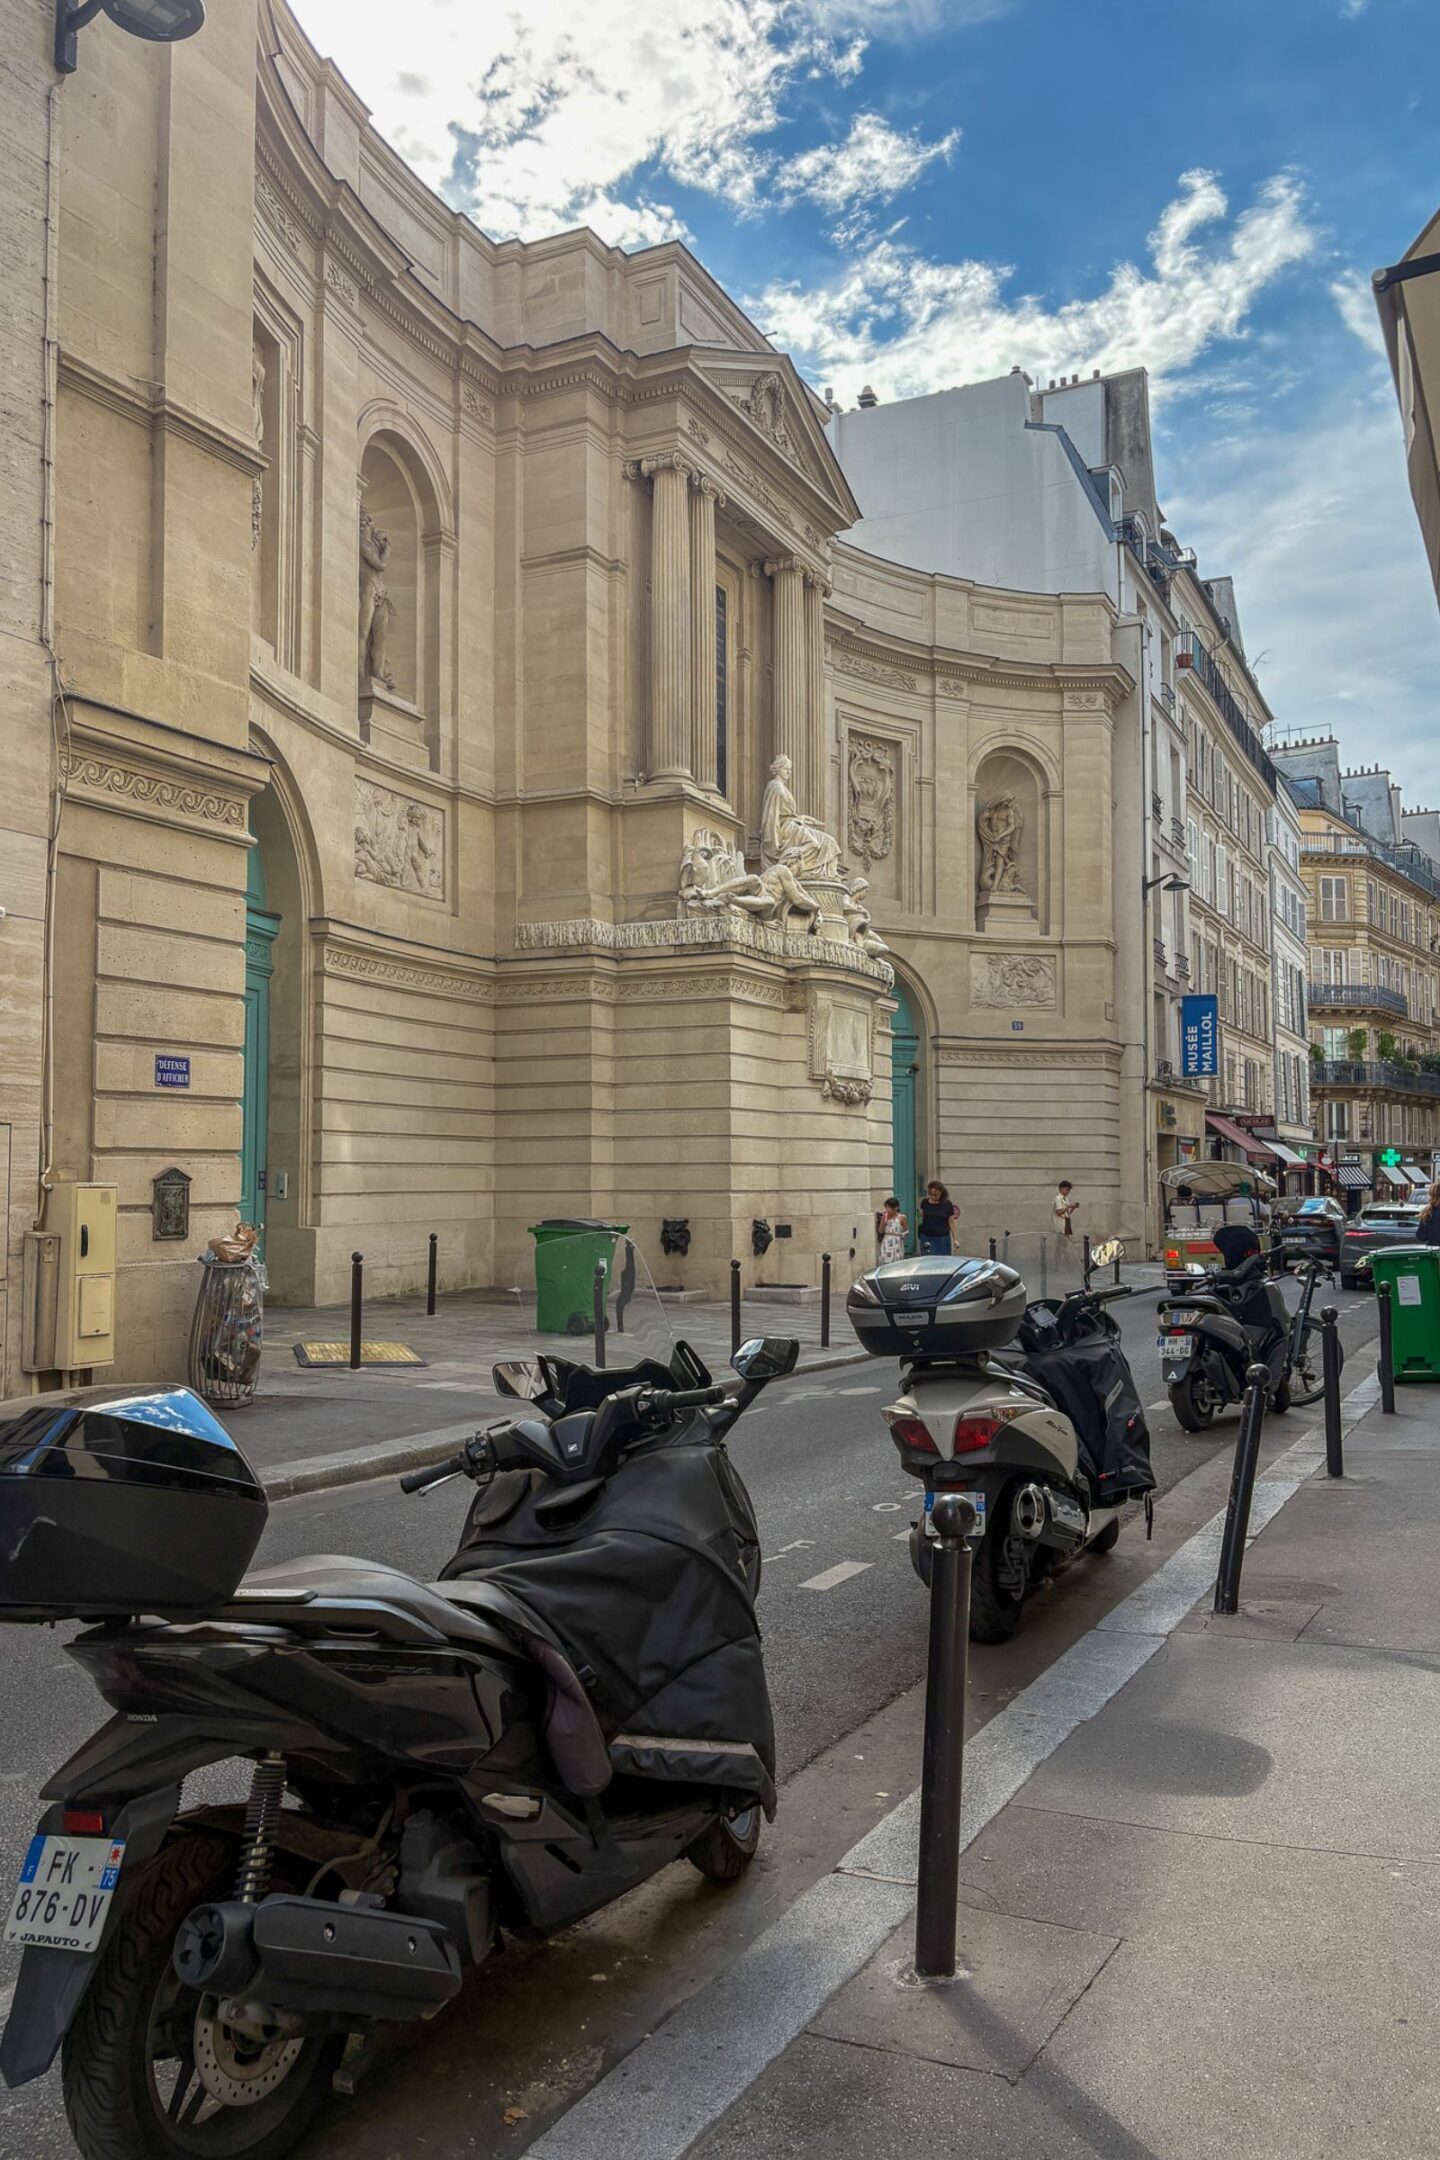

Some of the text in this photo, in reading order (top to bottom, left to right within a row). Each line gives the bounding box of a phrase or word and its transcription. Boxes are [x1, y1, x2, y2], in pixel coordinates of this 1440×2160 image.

[1185, 1026, 1198, 1072] MUSÉE
[1201, 1012, 1212, 1072] MAILLOL
[156, 1072, 189, 1083] D'AFFICHER
[127, 1713, 157, 1722] HONDA
[103, 1869, 116, 1886] 75
[16, 1889, 104, 1928] 876-DV
[20, 1933, 80, 1947] JAPAUTO
